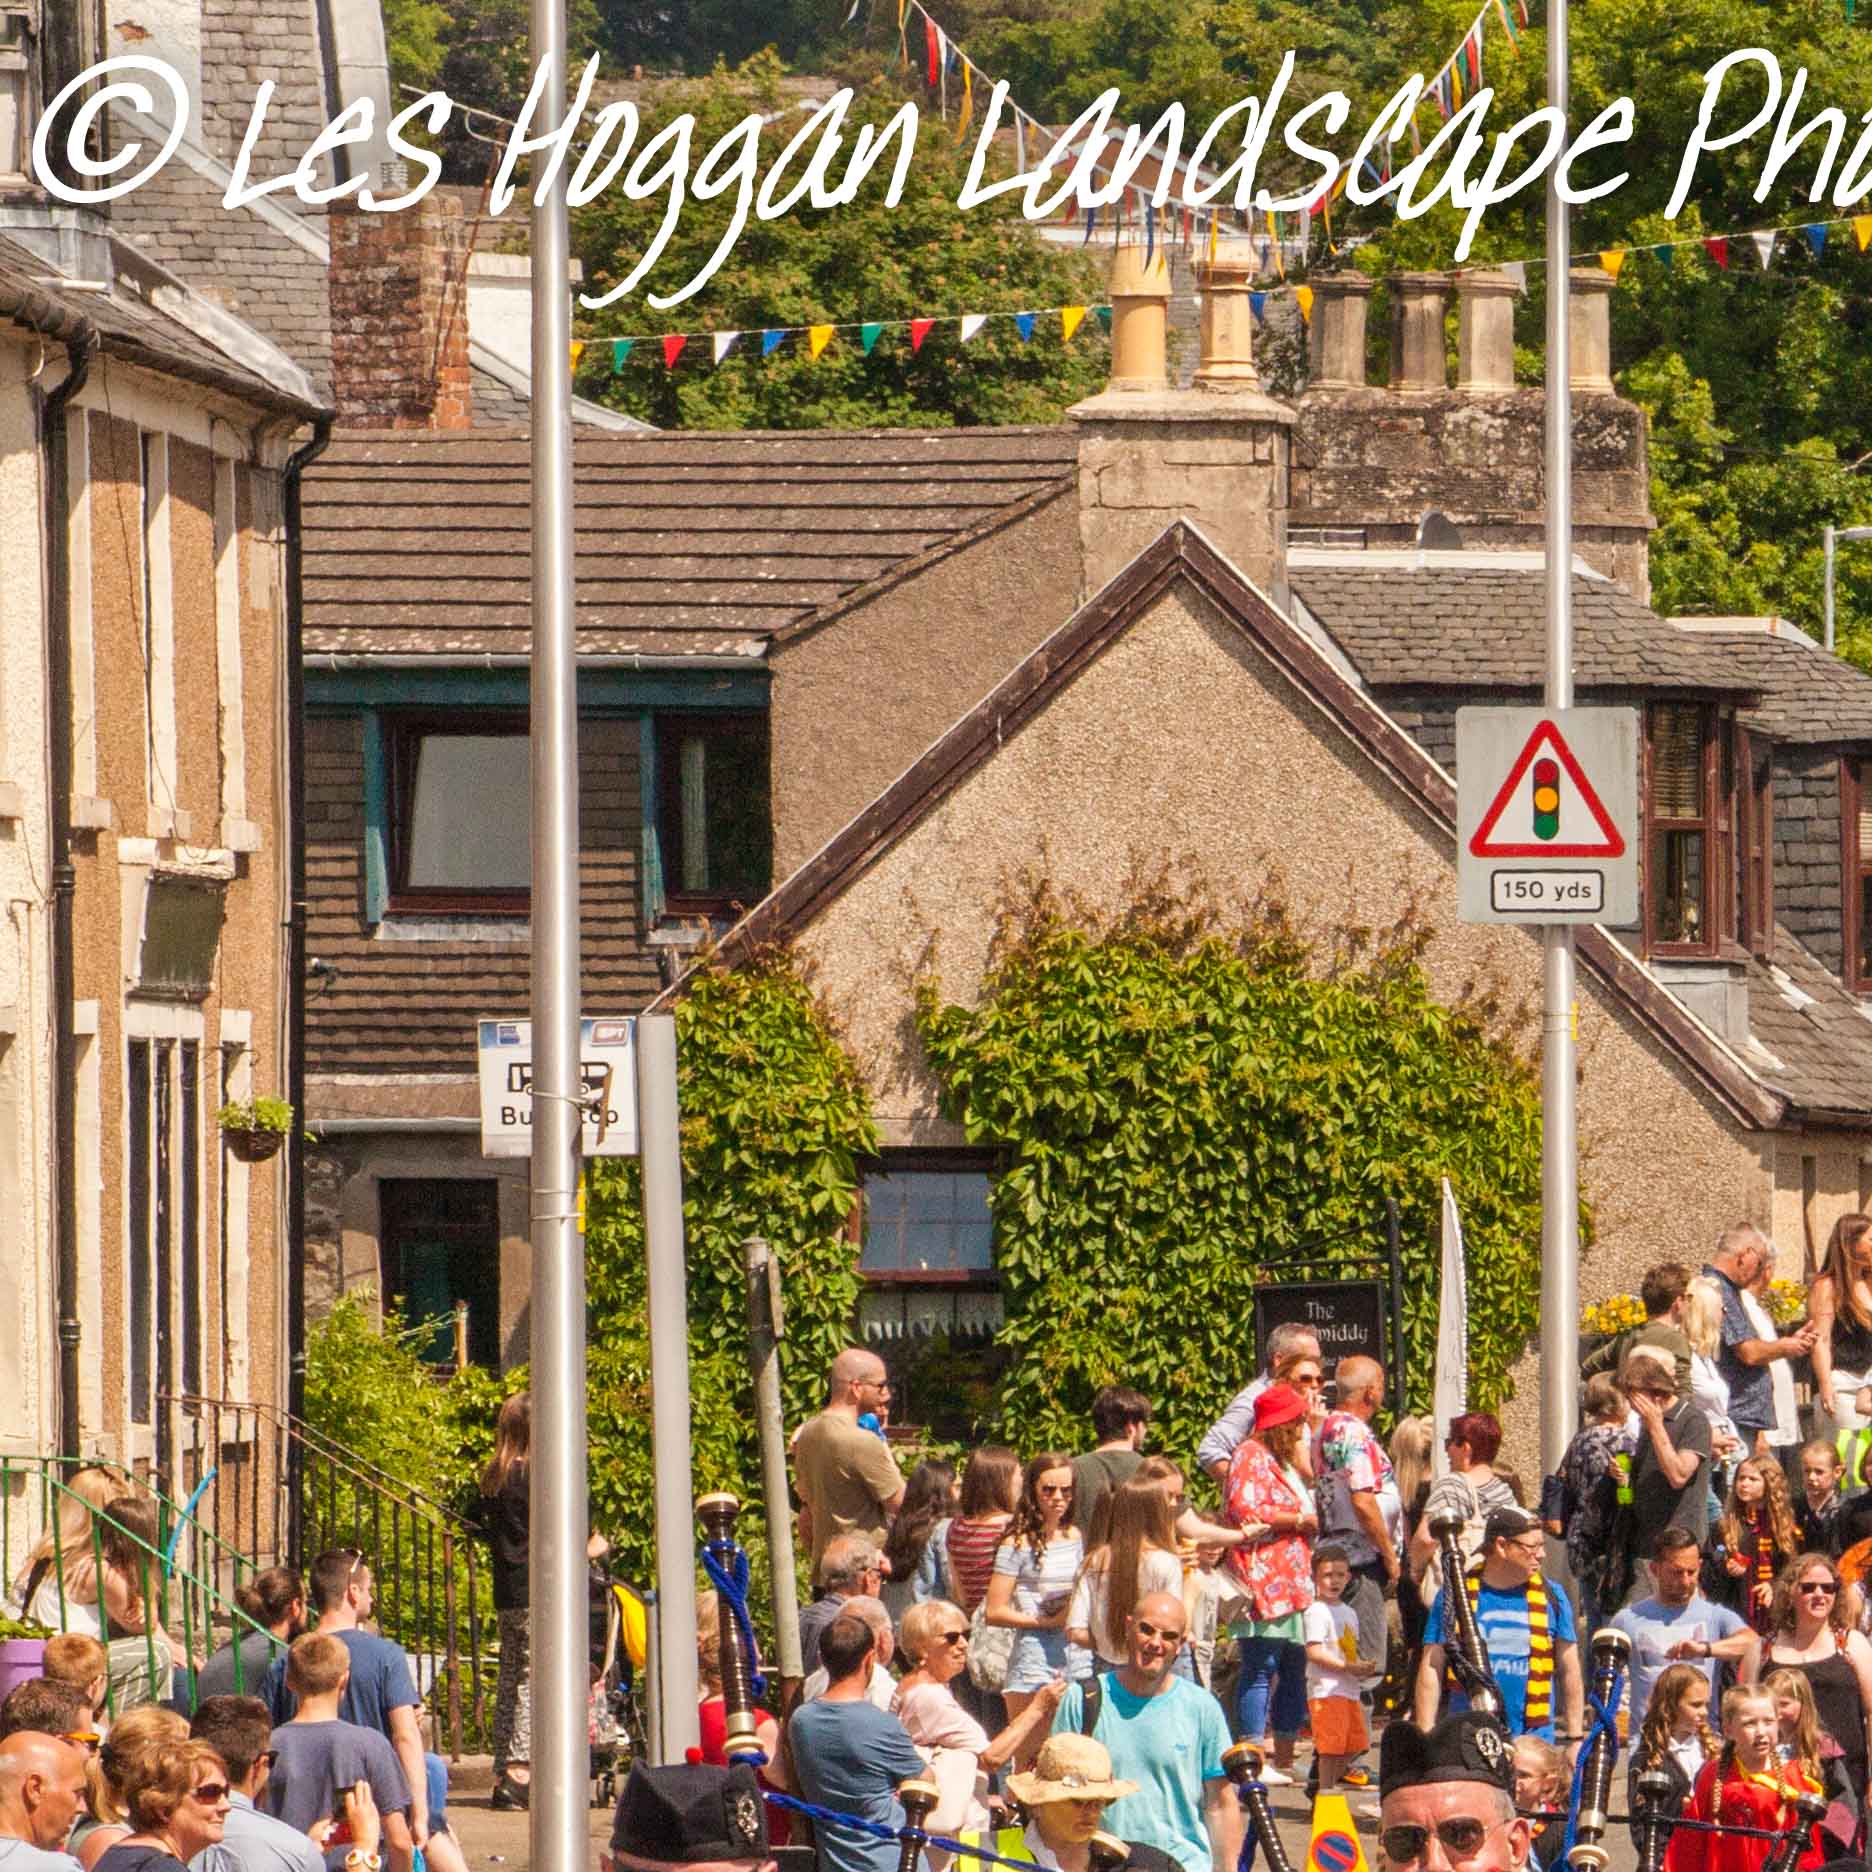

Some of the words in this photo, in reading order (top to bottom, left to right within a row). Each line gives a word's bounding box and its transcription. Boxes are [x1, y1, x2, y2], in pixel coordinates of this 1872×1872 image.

[1503, 880, 1543, 898] 150
[1555, 880, 1592, 902] yds
[501, 1106, 532, 1126] Bu
[581, 1106, 619, 1129] top
[1305, 1302, 1335, 1321] The
[1316, 1323, 1369, 1345] middy
